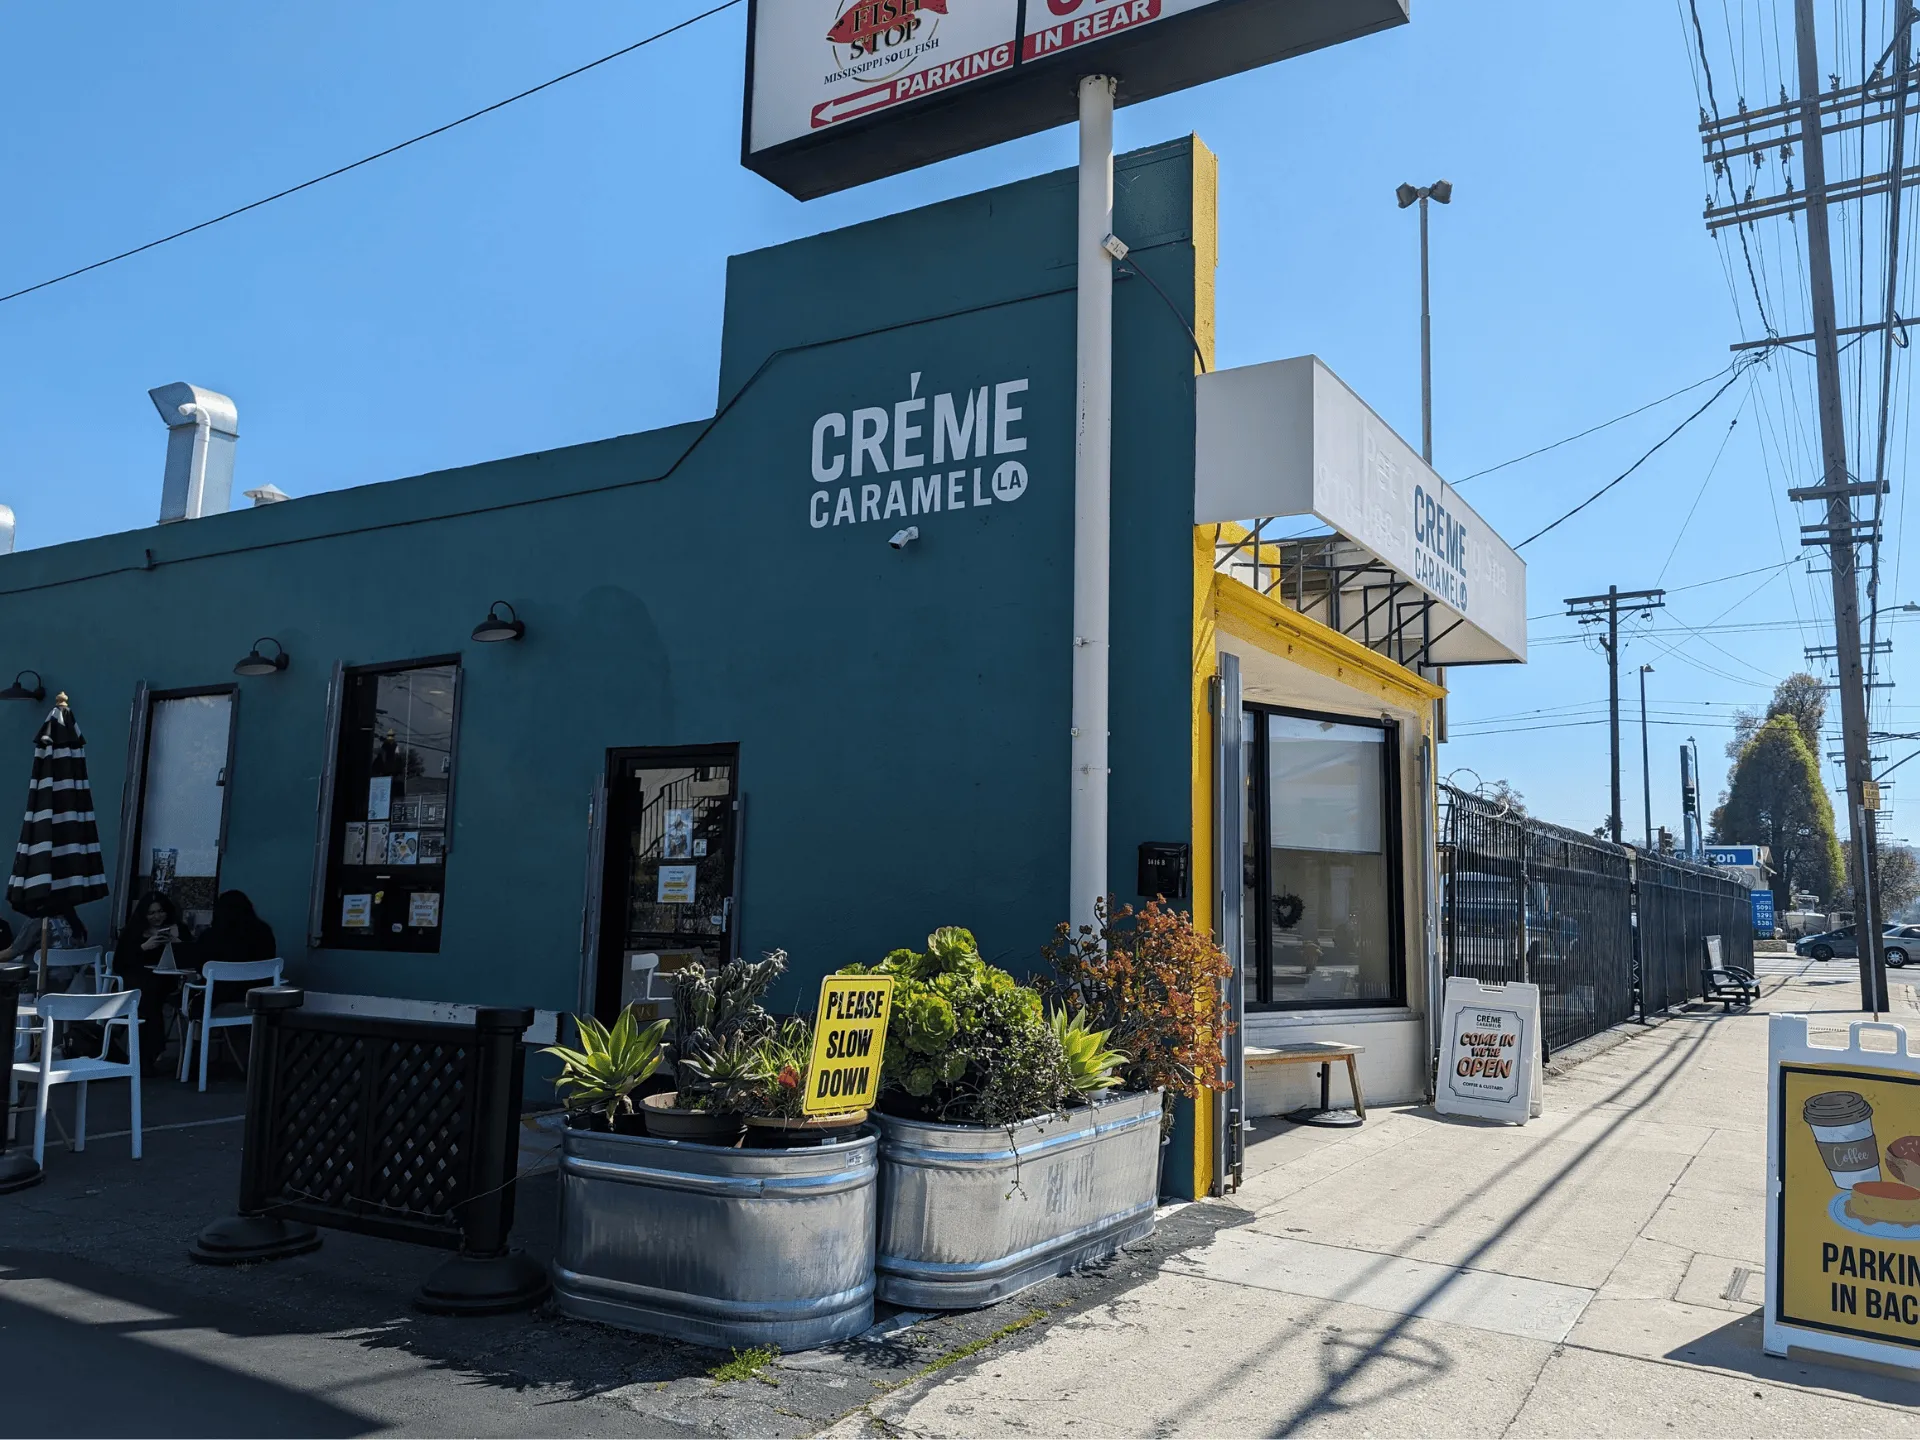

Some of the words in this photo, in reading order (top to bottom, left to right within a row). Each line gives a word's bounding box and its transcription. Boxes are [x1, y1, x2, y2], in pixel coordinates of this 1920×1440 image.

[850, 18, 921, 60] STOP
[895, 44, 1009, 99] PARKING
[1034, 26, 1063, 54] IN
[1073, 0, 1150, 41] REAR
[824, 57, 883, 84] MISSISSIPPI
[884, 48, 913, 65] SOUL
[915, 38, 939, 57] FISH
[825, 990, 885, 1020] PLEASE
[825, 1028, 874, 1059] SLOW
[1460, 1032, 1498, 1047] COME
[1499, 1033, 1516, 1048] IN
[1471, 1047, 1501, 1057] WE'RE
[816, 1066, 870, 1098] DOWN
[1456, 1056, 1513, 1078] OPEN
[1832, 1145, 1869, 1167] Coffee
[1831, 1282, 1857, 1315] IN
